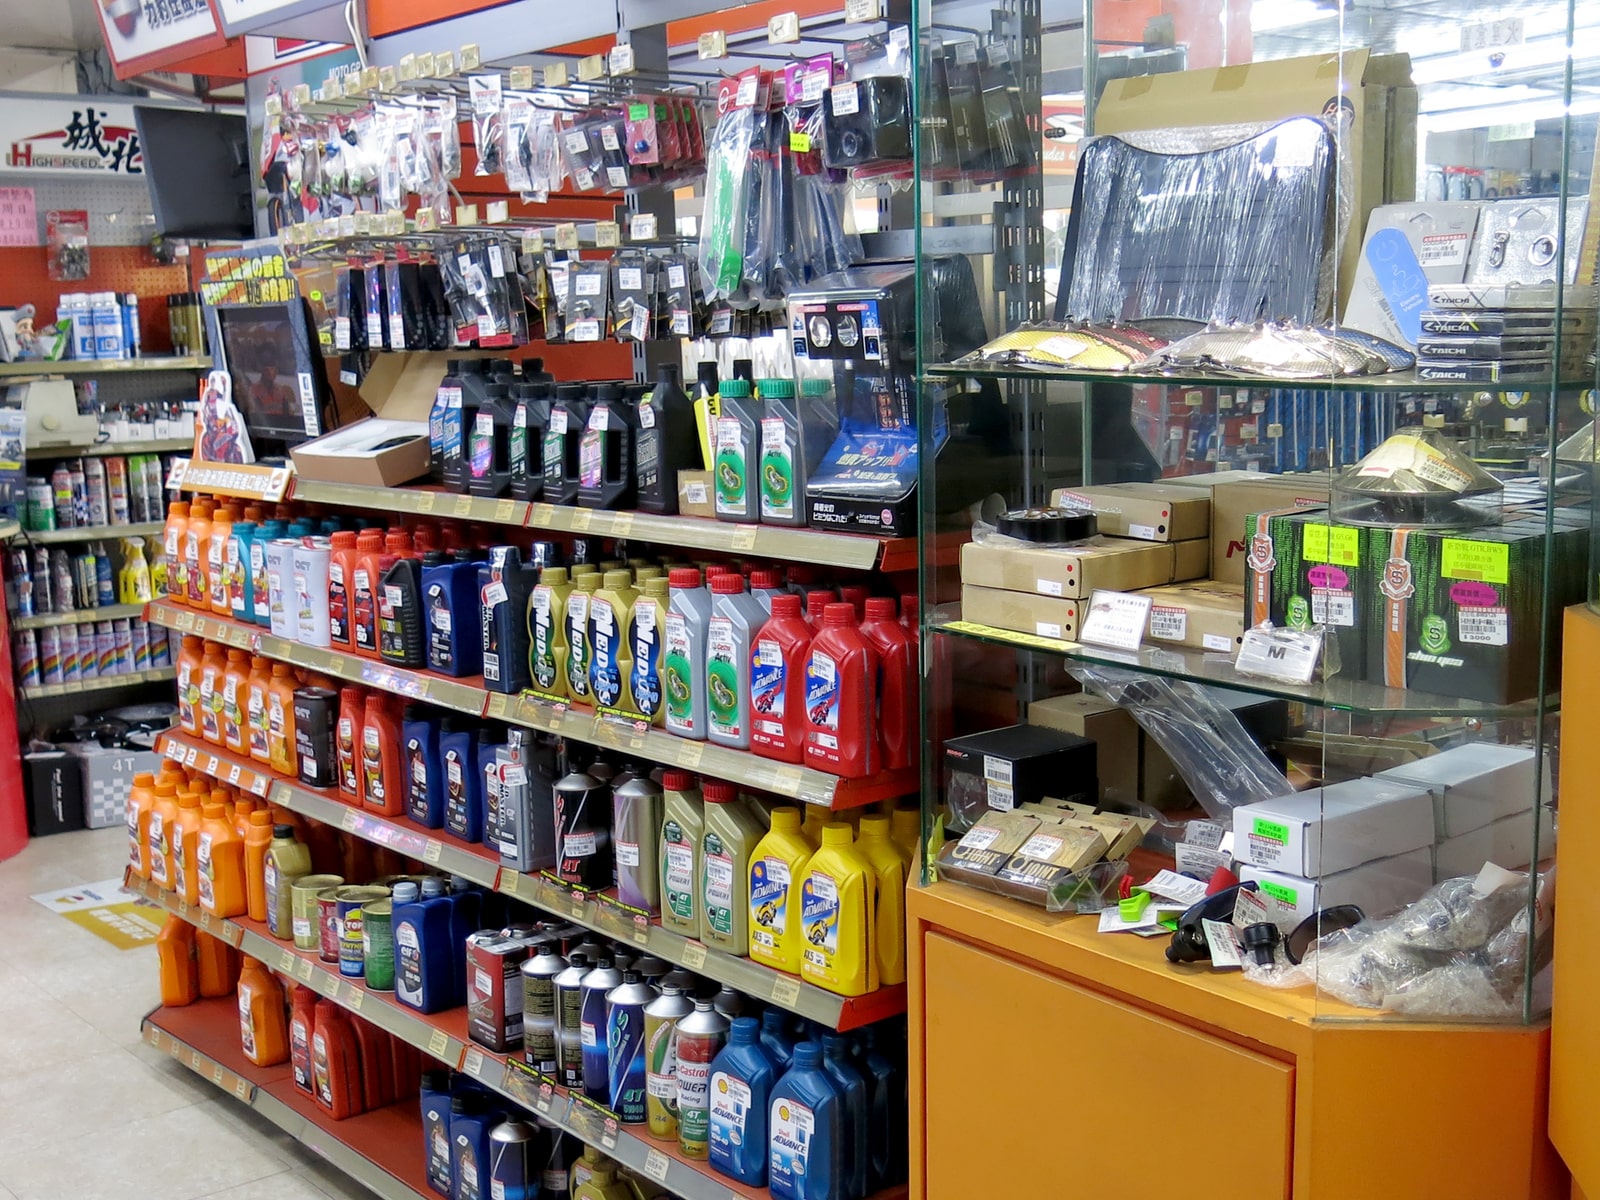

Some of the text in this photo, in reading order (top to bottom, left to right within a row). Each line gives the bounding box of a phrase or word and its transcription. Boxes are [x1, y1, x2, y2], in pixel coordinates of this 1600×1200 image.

[62, 107, 143, 174] 城北
[1430, 371, 1467, 379] TAICHI
[112, 757, 135, 773] 4T
[1022, 861, 1061, 880] JOINT
[752, 881, 786, 900] ADVANCE
[804, 900, 838, 918] ADVANCE
[680, 1064, 709, 1078] Castrol
[623, 1088, 645, 1103] 4T
[687, 1110, 702, 1119] 4T
[711, 1107, 744, 1125] ADVANCE
[778, 1128, 790, 1138] Shell
[772, 1135, 808, 1154] ADVANCE
